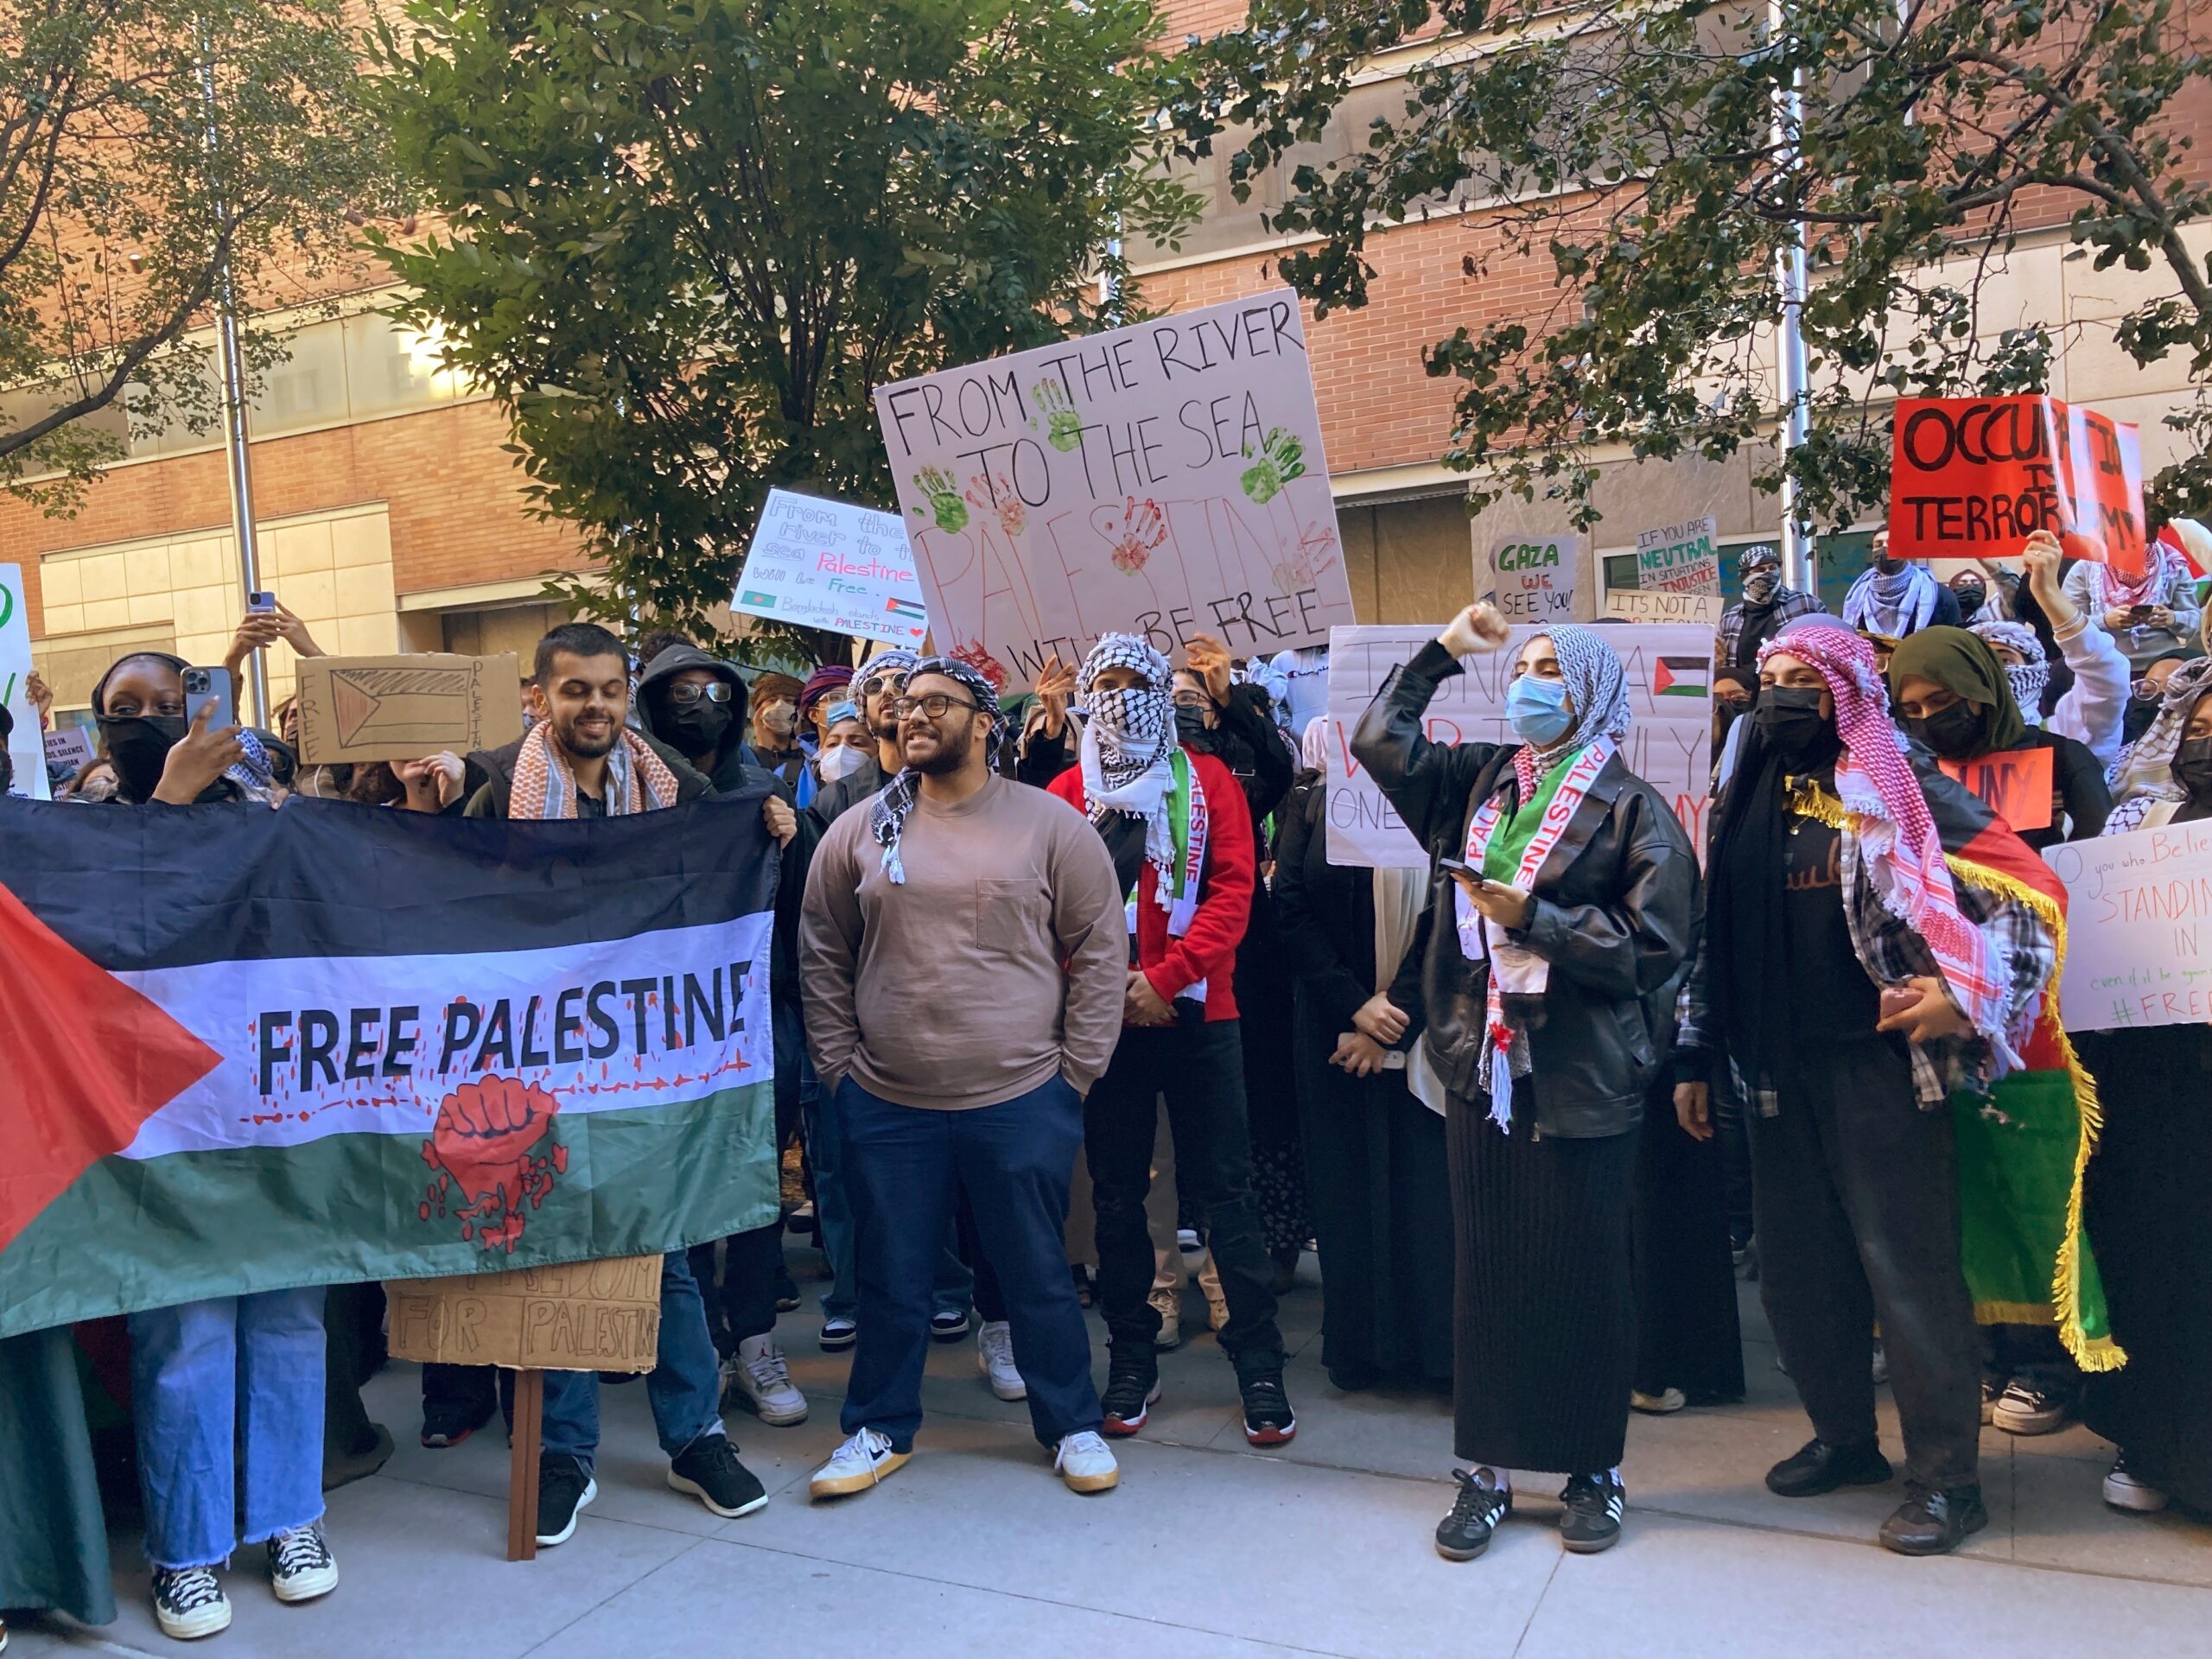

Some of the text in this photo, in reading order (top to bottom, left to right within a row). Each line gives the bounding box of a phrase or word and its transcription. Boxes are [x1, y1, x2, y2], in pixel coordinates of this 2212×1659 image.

[887, 300, 1306, 456] FROM THE RIVER
[956, 390, 1272, 509] TO THE SEA
[769, 496, 905, 539] From the
[1638, 518, 1710, 549] IF YOU ARE
[779, 522, 847, 546] river
[857, 536, 881, 556] to
[1498, 543, 1560, 572] GAZA
[1639, 535, 1717, 570] NEUTRAL
[762, 542, 805, 560] sea
[817, 552, 915, 582] Palestine
[795, 572, 816, 585] be
[914, 474, 1349, 650] PALESTINE
[1521, 574, 1554, 590] WE
[1639, 558, 1712, 585] IN SITUATIONS
[1135, 607, 1199, 657] BE
[1206, 588, 1326, 647] FREE
[1503, 592, 1540, 615] SEE
[1655, 596, 1692, 614] NOT
[1694, 596, 1708, 618] A
[834, 617, 905, 636] PALESTINE
[300, 674, 321, 762] FREE
[1185, 764, 1207, 883] ALESTINE
[1516, 743, 1606, 886] PALESTINE
[2088, 861, 2114, 899] you
[2121, 850, 2145, 868] who
[2150, 830, 2212, 864] Belie
[2174, 923, 2197, 957] IN
[259, 958, 753, 1096] FREE PALESTINE
[397, 1295, 488, 1354] FOR
